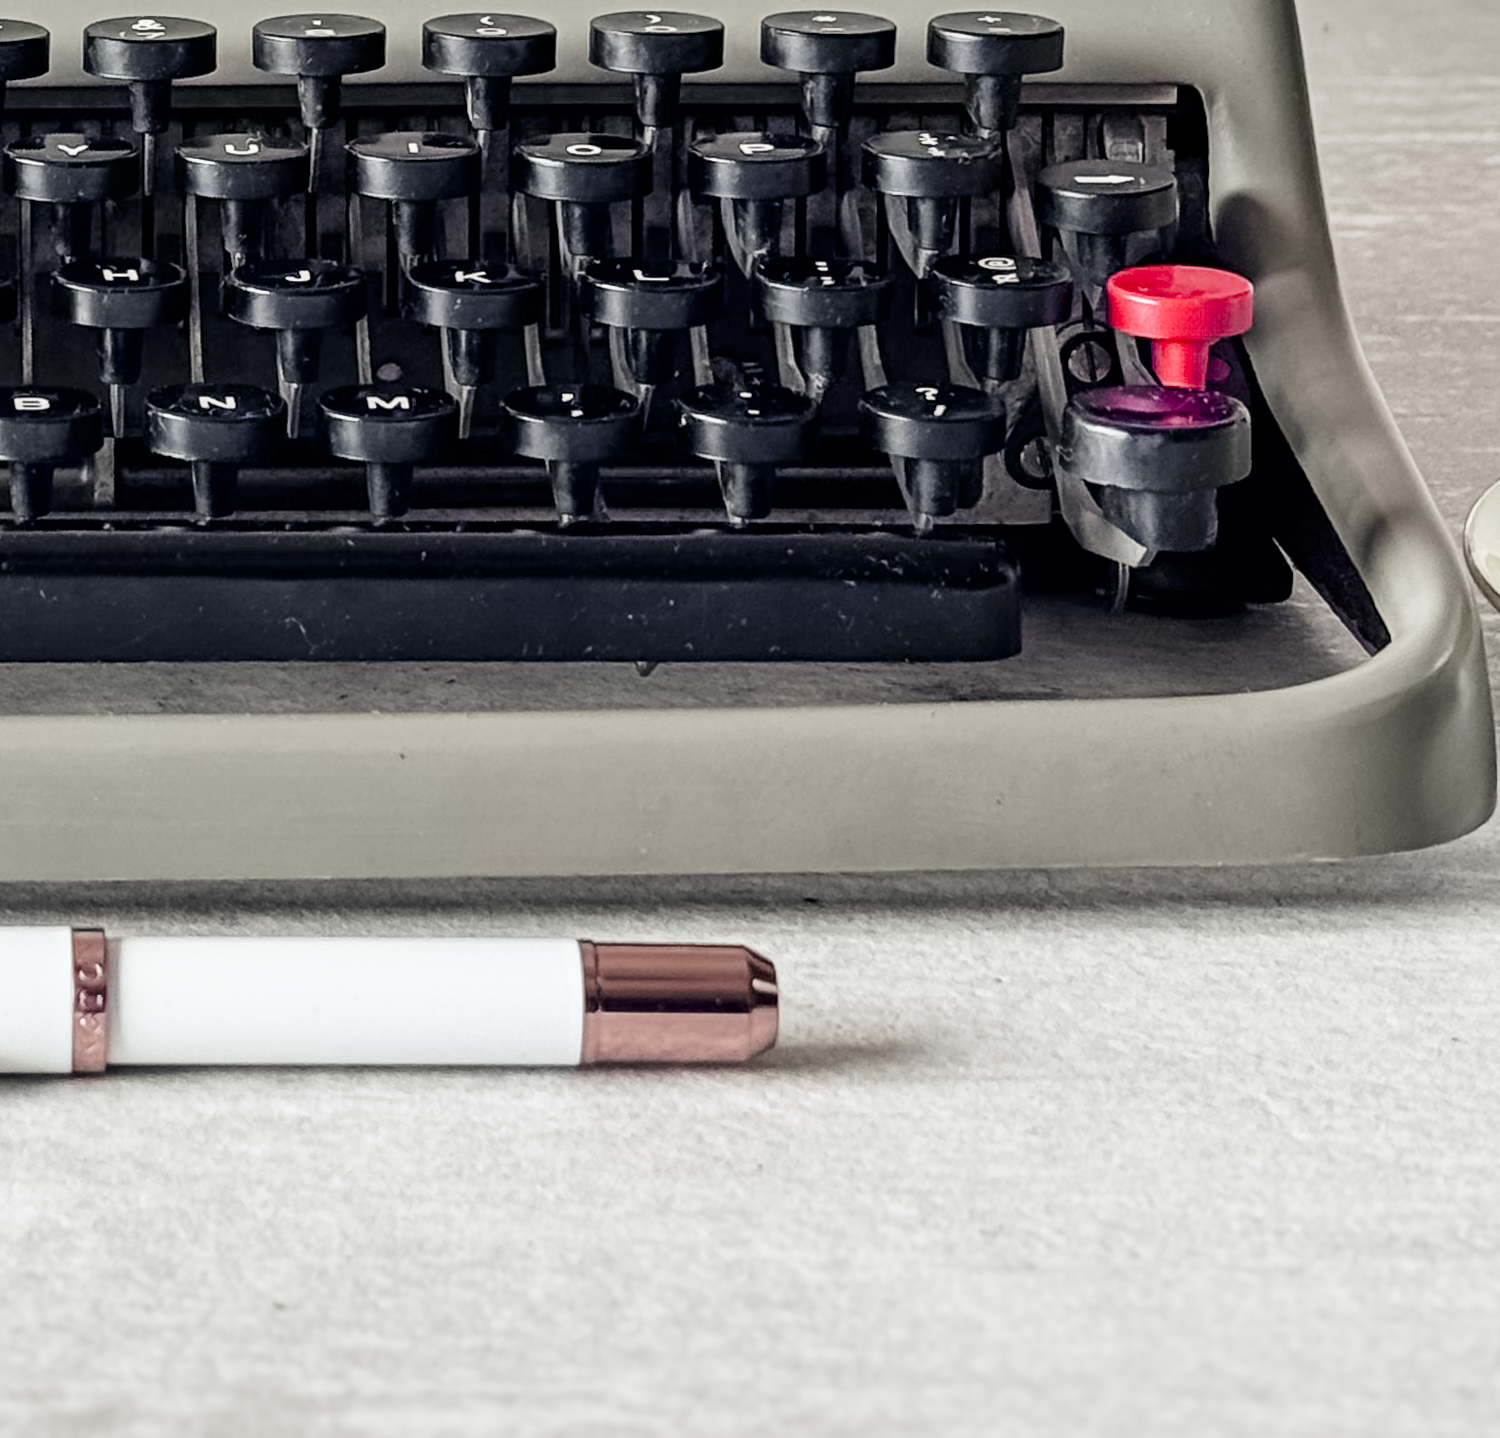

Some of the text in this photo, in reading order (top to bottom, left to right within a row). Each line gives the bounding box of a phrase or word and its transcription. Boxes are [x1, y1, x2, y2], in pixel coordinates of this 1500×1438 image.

[57, 144, 89, 156] Y
[224, 143, 259, 155] U
[566, 144, 602, 156] O
[739, 143, 775, 155] P
[102, 269, 139, 281] H
[284, 270, 311, 282] J
[454, 270, 492, 284] K
[632, 269, 670, 281] L
[13, 397, 50, 411] B
[198, 396, 236, 410] N
[366, 396, 410, 410] M
